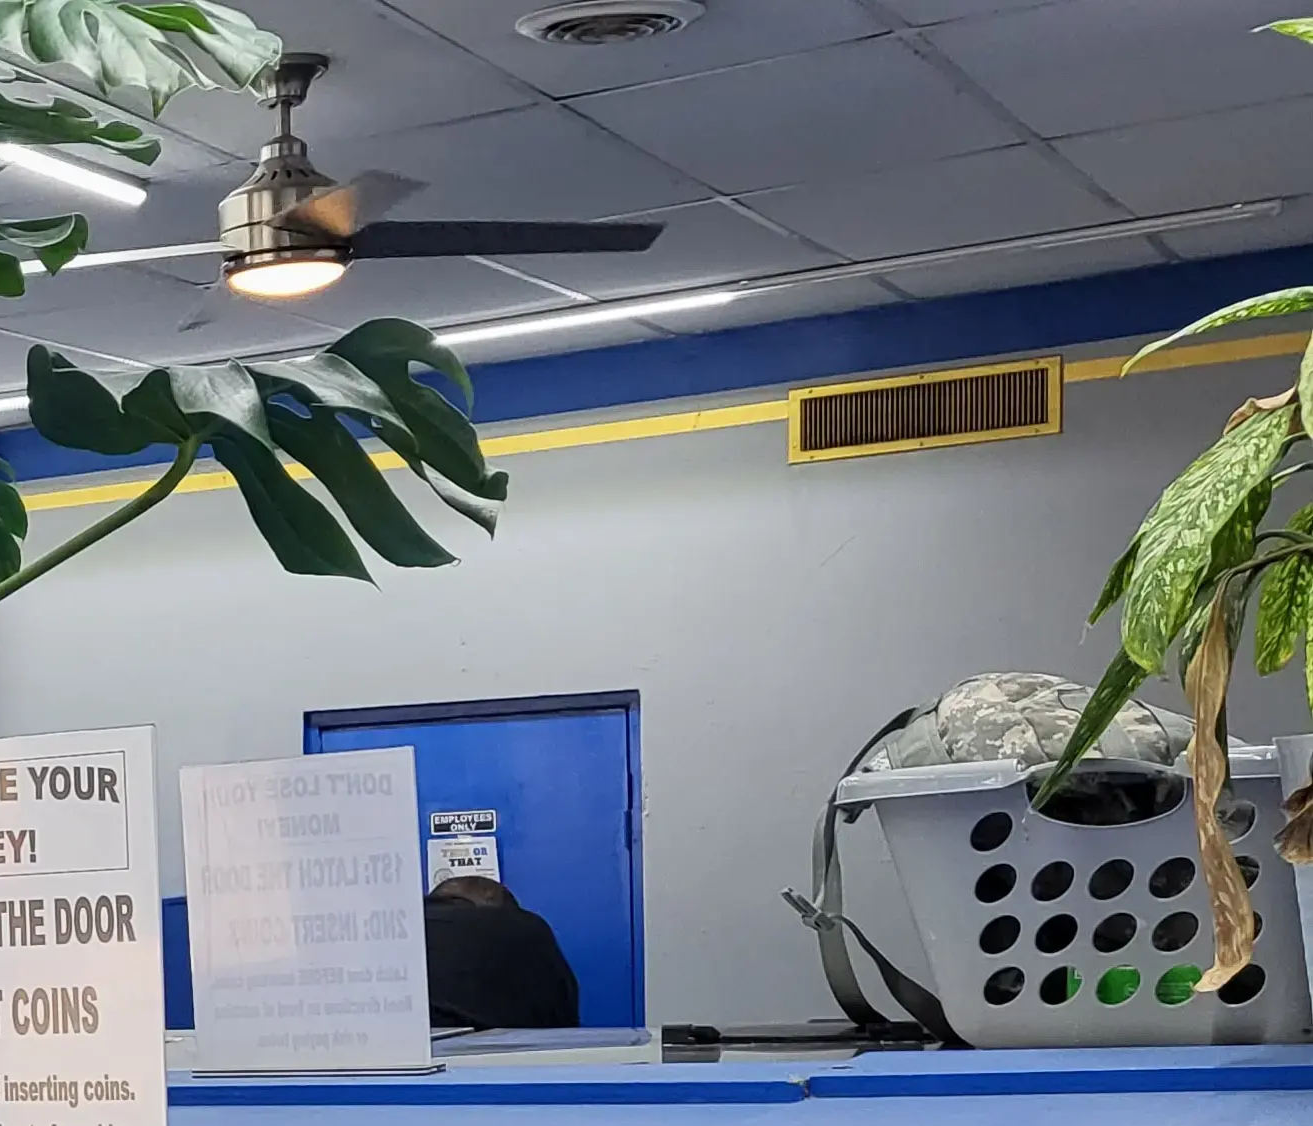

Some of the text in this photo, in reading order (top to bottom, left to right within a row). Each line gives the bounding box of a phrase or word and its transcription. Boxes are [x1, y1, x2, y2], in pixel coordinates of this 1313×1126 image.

[28, 766, 120, 803] YOUR
[434, 813, 492, 825] EMPLOYEES
[450, 822, 477, 832] ONLY
[448, 857, 482, 867] THAT
[54, 894, 136, 945] DOOR
[11, 985, 100, 1035] COINS
[4, 1074, 78, 1108] inserting
[84, 1074, 136, 1101] coins.
